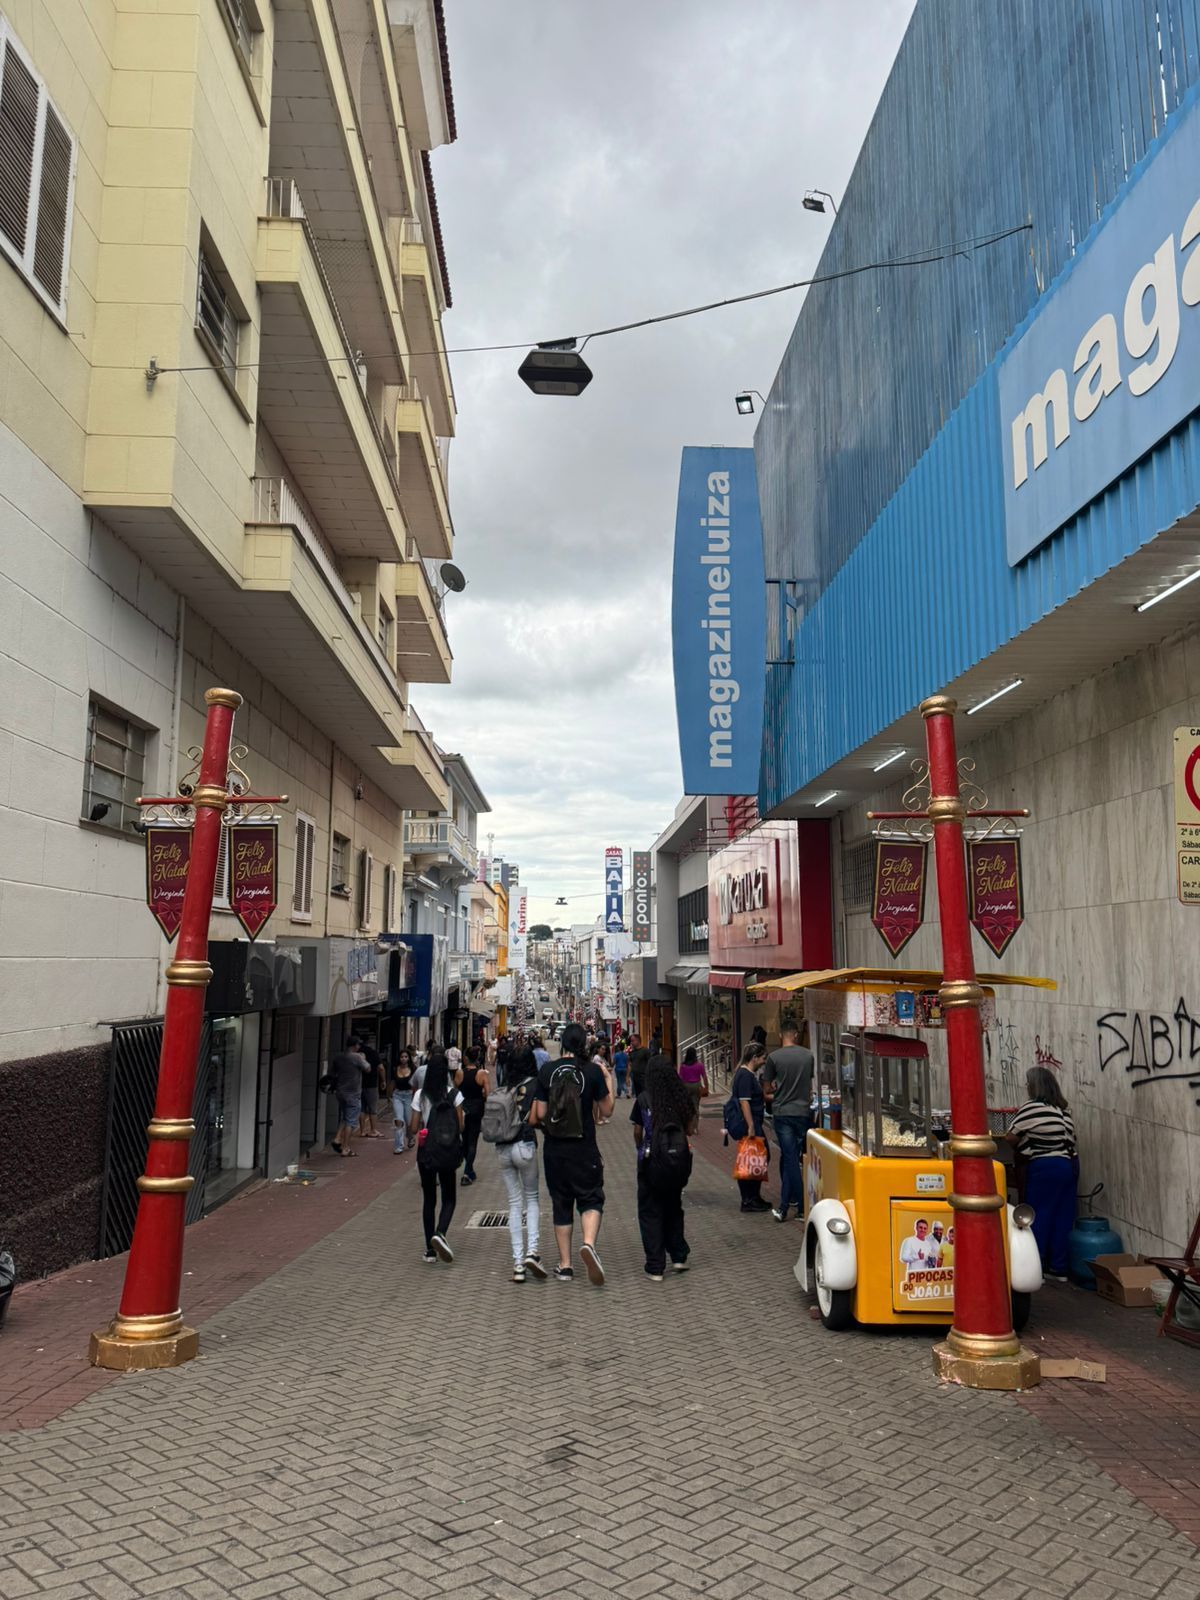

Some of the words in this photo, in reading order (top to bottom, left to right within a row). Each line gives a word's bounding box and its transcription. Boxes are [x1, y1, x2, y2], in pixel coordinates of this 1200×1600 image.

[700, 470, 740, 769] magazineluiza
[153, 843, 182, 863] Feliz
[236, 841, 265, 862] Feliz
[236, 857, 273, 881] Natal
[881, 857, 914, 876] Feliz
[976, 855, 1007, 876] Feliz
[606, 857, 622, 923] BAHIA
[880, 875, 921, 896] Natal
[976, 872, 1016, 896] Natal
[517, 896, 527, 934] Karina
[903, 1283, 913, 1291] DO
[908, 1270, 953, 1283] PIPOCAS
[910, 1283, 940, 1298] JOÃO
